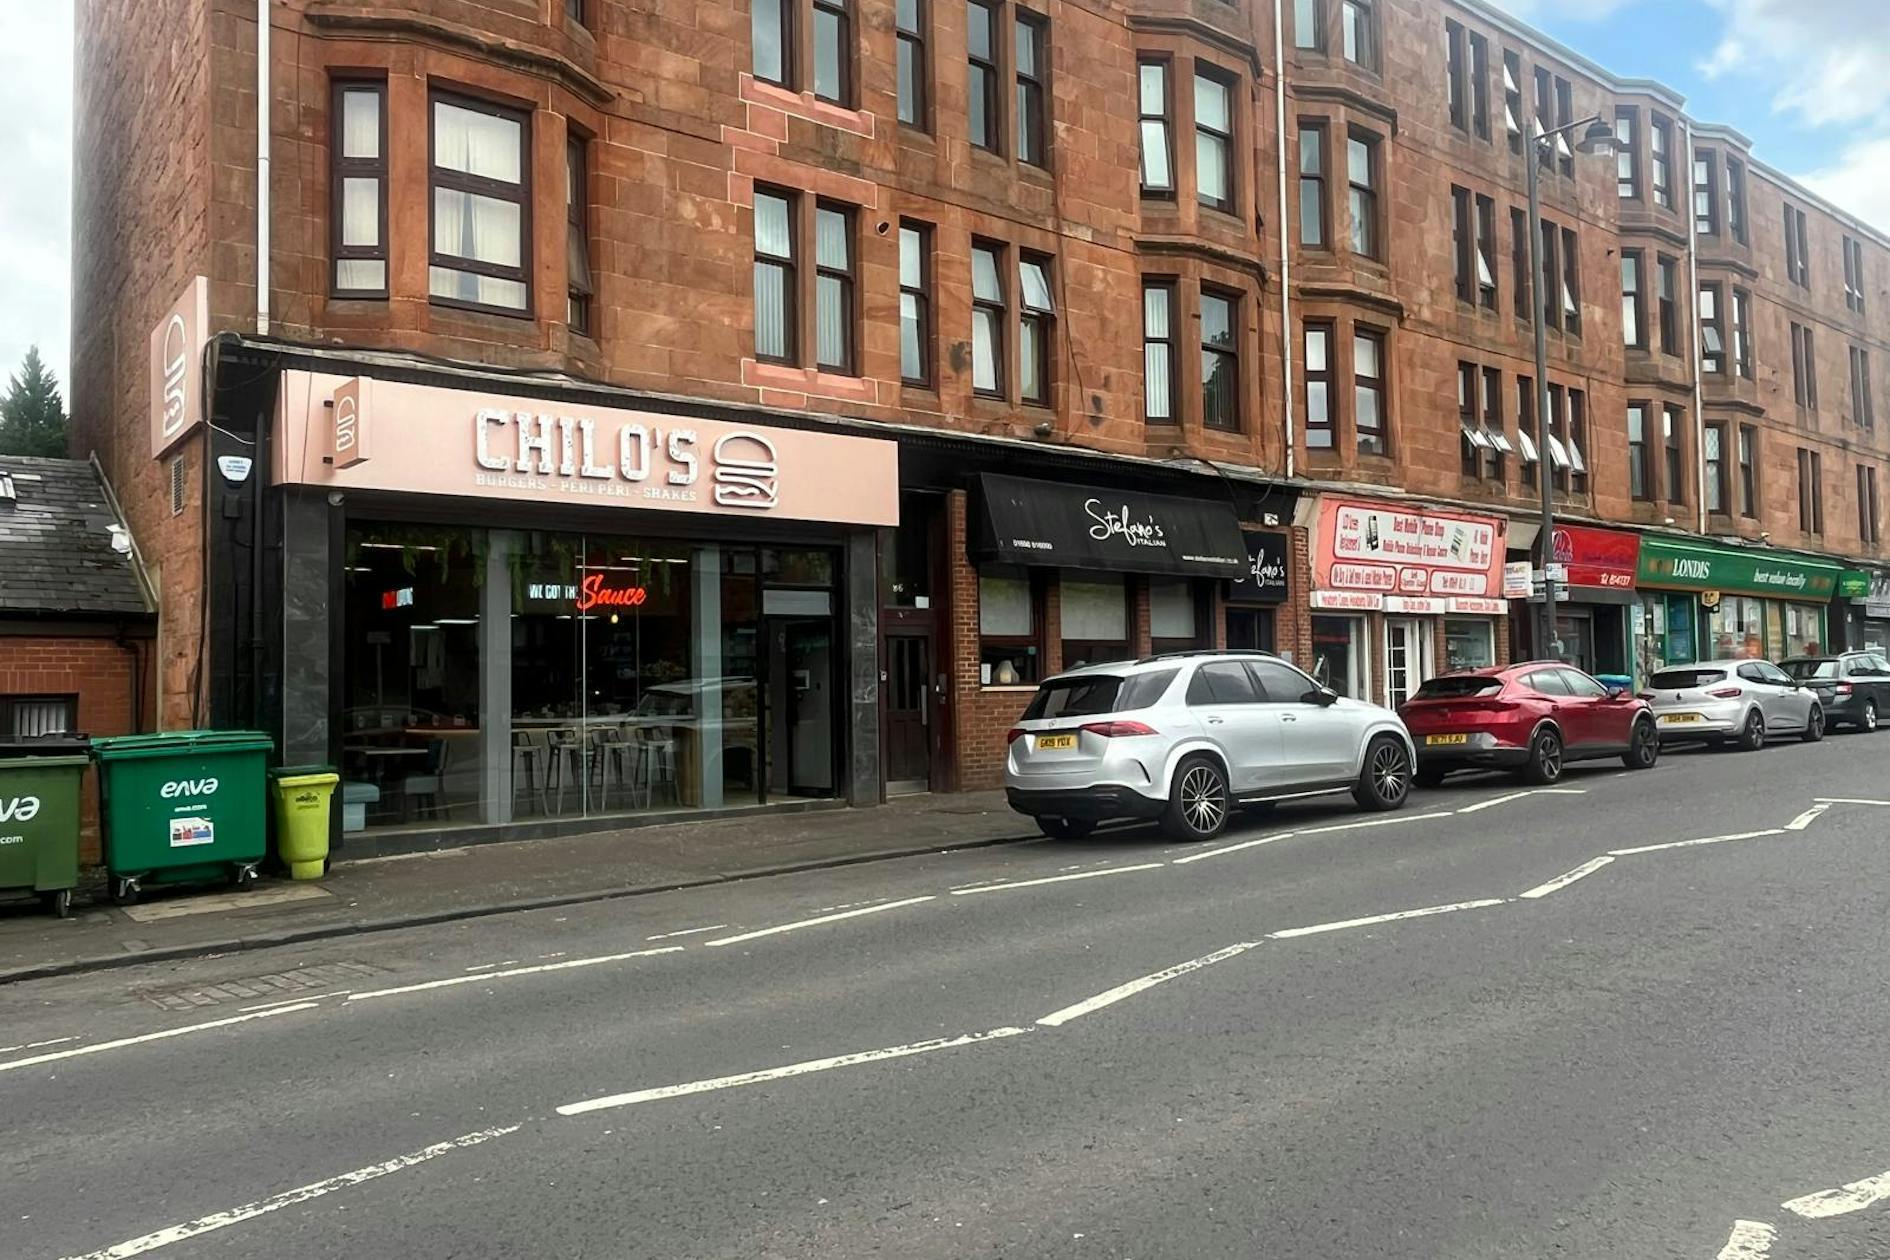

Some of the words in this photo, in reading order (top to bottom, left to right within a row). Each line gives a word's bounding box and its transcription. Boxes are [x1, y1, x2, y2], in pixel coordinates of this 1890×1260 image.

[476, 408, 699, 485] CHILO'S
[475, 473, 547, 491] BURGERS
[561, 480, 594, 495] PERI
[597, 483, 630, 498] PERI
[643, 487, 697, 502] SHAKES
[1084, 498, 1164, 547] Stefano's
[1234, 548, 1285, 588] efano's
[1672, 558, 1710, 580] LONDIS
[576, 573, 647, 610] Sauce
[160, 777, 219, 798] enva
